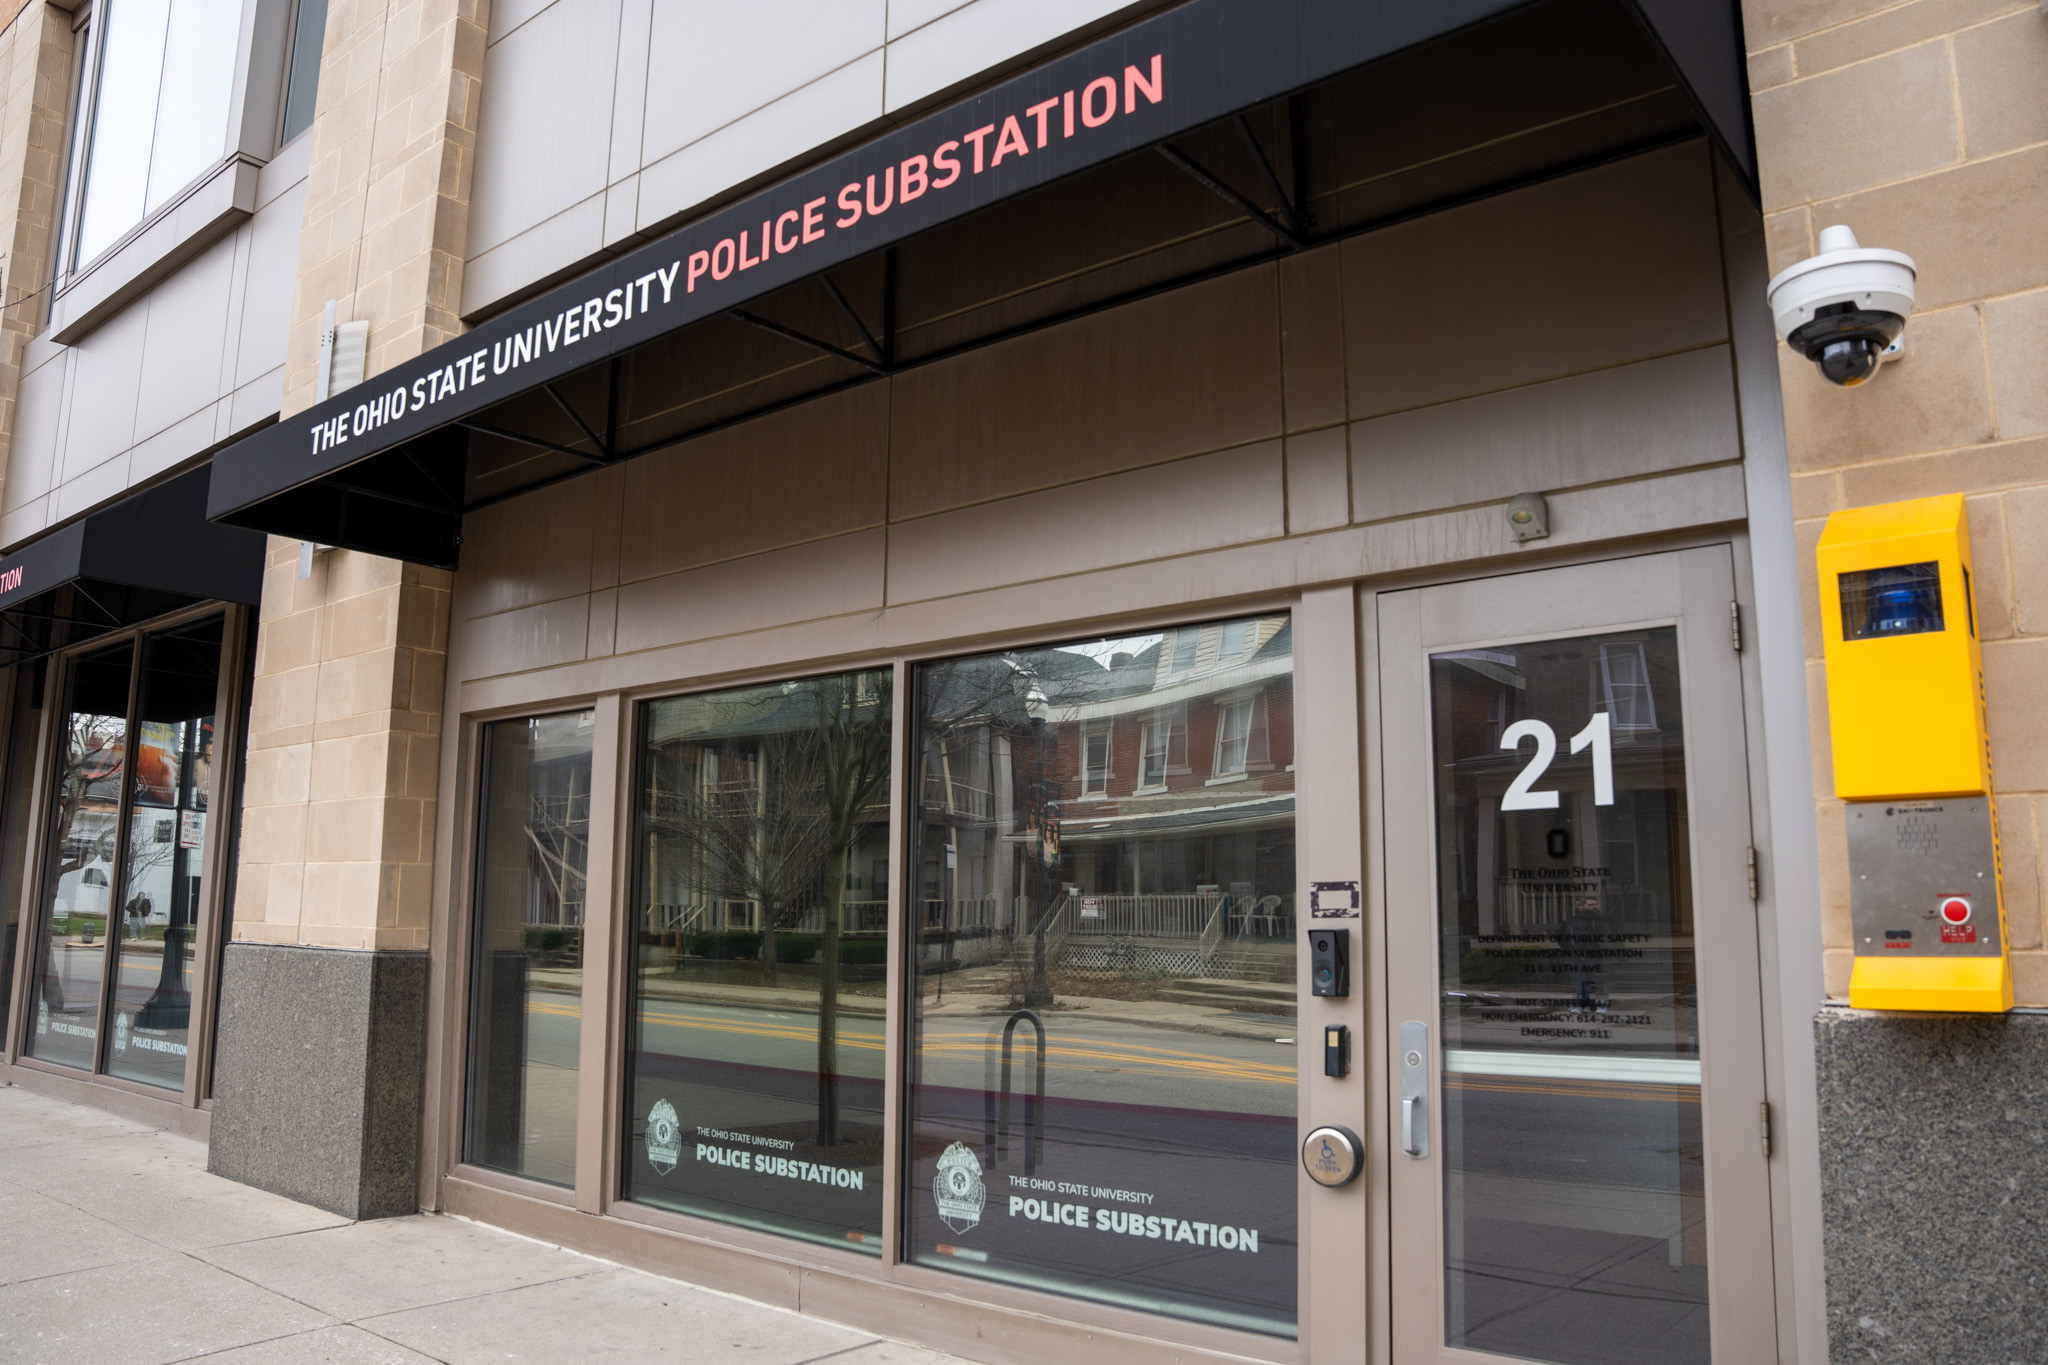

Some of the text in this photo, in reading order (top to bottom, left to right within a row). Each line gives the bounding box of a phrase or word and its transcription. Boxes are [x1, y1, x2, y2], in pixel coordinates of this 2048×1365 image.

[311, 54, 1163, 455] THE OHIO STATE UNIVERSITY POLICE SUBSTATION
[1499, 711, 1614, 811] 21
[1943, 926, 1973, 937] HELP
[1477, 934, 1545, 943] DEPARTMENT
[1607, 934, 1650, 943] SAFETY
[1485, 949, 1643, 958] POLICE DIVISION SUBSTATION
[1516, 998, 1536, 1007] NOT
[1539, 998, 1588, 1007] STAFFE
[1576, 1015, 1651, 1025] 614-292-2121
[51, 1022, 67, 1032] POLICE
[1589, 1029, 1609, 1039] 911
[131, 1036, 152, 1050] POLICE
[697, 1126, 794, 1151] THE OHIO STATE UNIVERSITY
[696, 1143, 863, 1190] POLICE SUBSTATION
[1009, 1175, 1154, 1205] THE OHIO STATE UNIVERSITY
[1009, 1196, 1258, 1253] POLICE SUBSTATION
